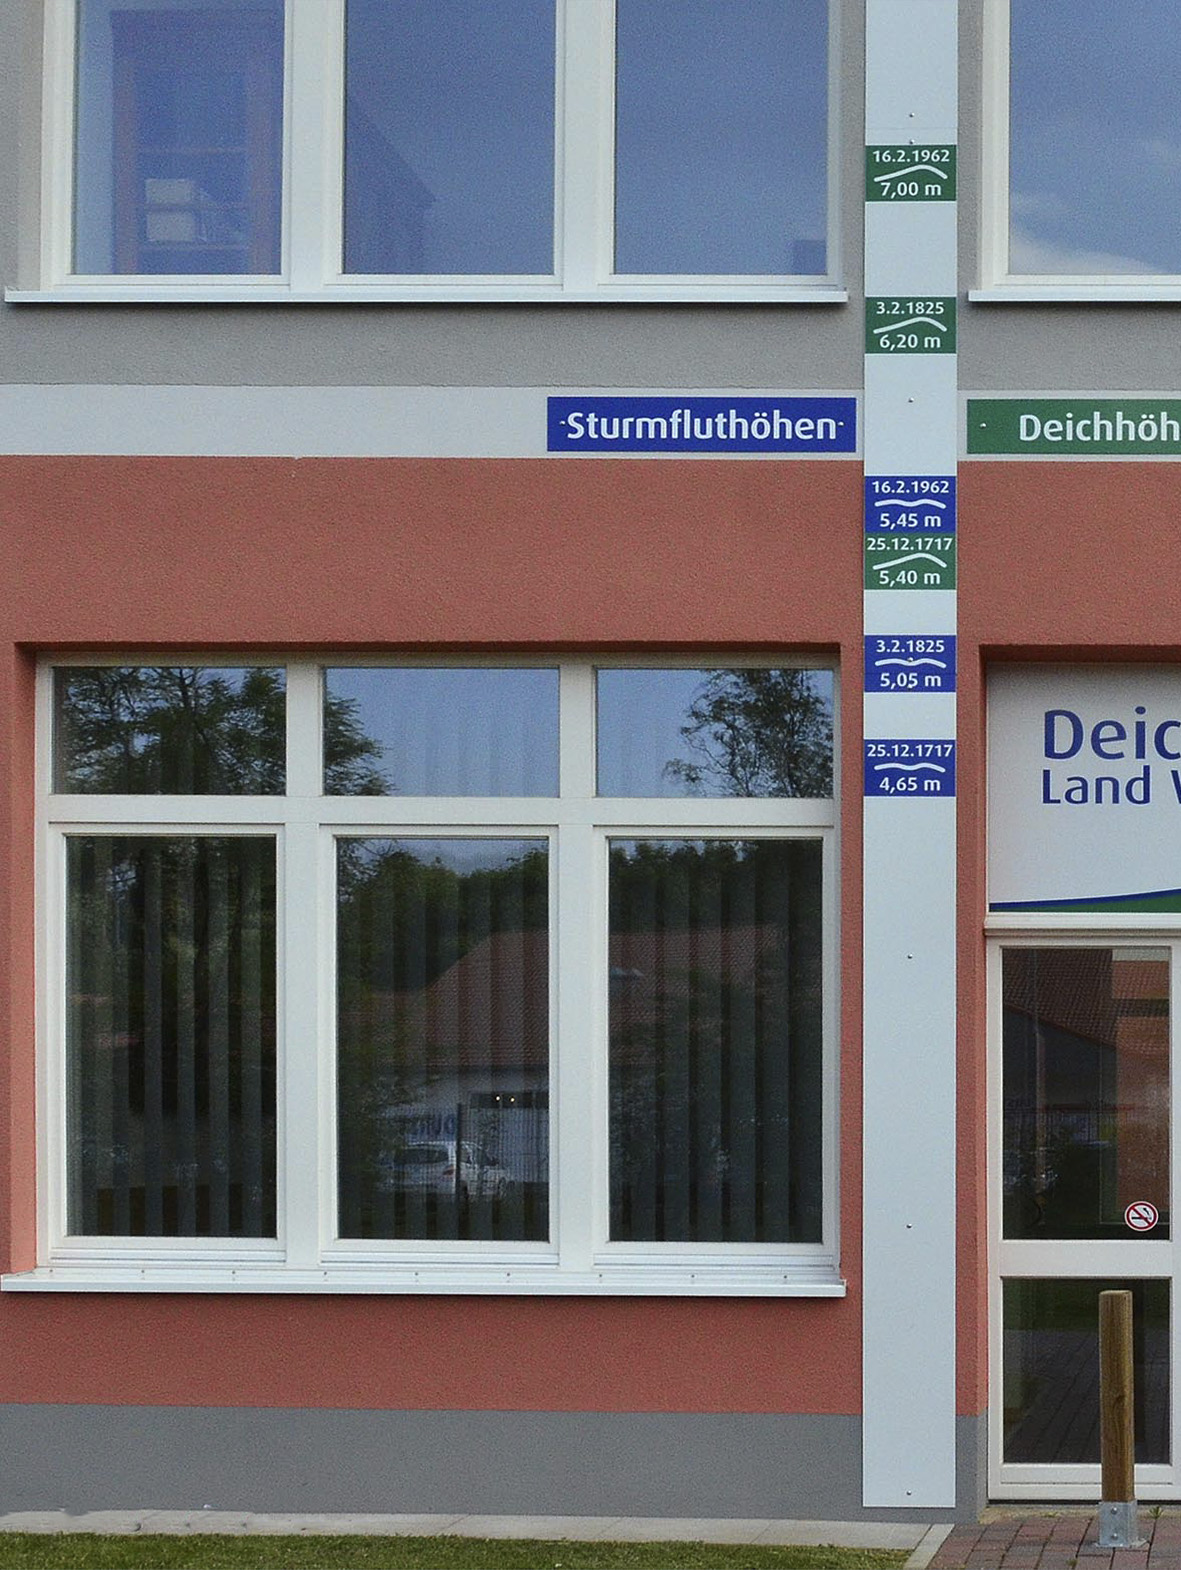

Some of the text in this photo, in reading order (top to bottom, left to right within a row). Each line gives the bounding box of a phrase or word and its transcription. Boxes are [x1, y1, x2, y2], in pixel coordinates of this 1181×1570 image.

[872, 149, 950, 163] 16.2.1962
[879, 181, 942, 200] 7,00 m
[876, 301, 945, 315] 3.2.1825
[878, 333, 941, 352] 6,20 m
[567, 409, 836, 440] Sturmfluthöhen
[871, 480, 950, 494] 16.2.1962
[879, 513, 942, 530] 5,45 m
[867, 537, 953, 551] 25.12.1717
[878, 569, 941, 588] 5,40 m
[876, 639, 945, 653] 3.2.1825
[880, 672, 942, 690] 5,05 m
[867, 743, 953, 757] 25.12.1717
[879, 776, 941, 794] 4,65 m
[1042, 764, 1151, 805] Land
